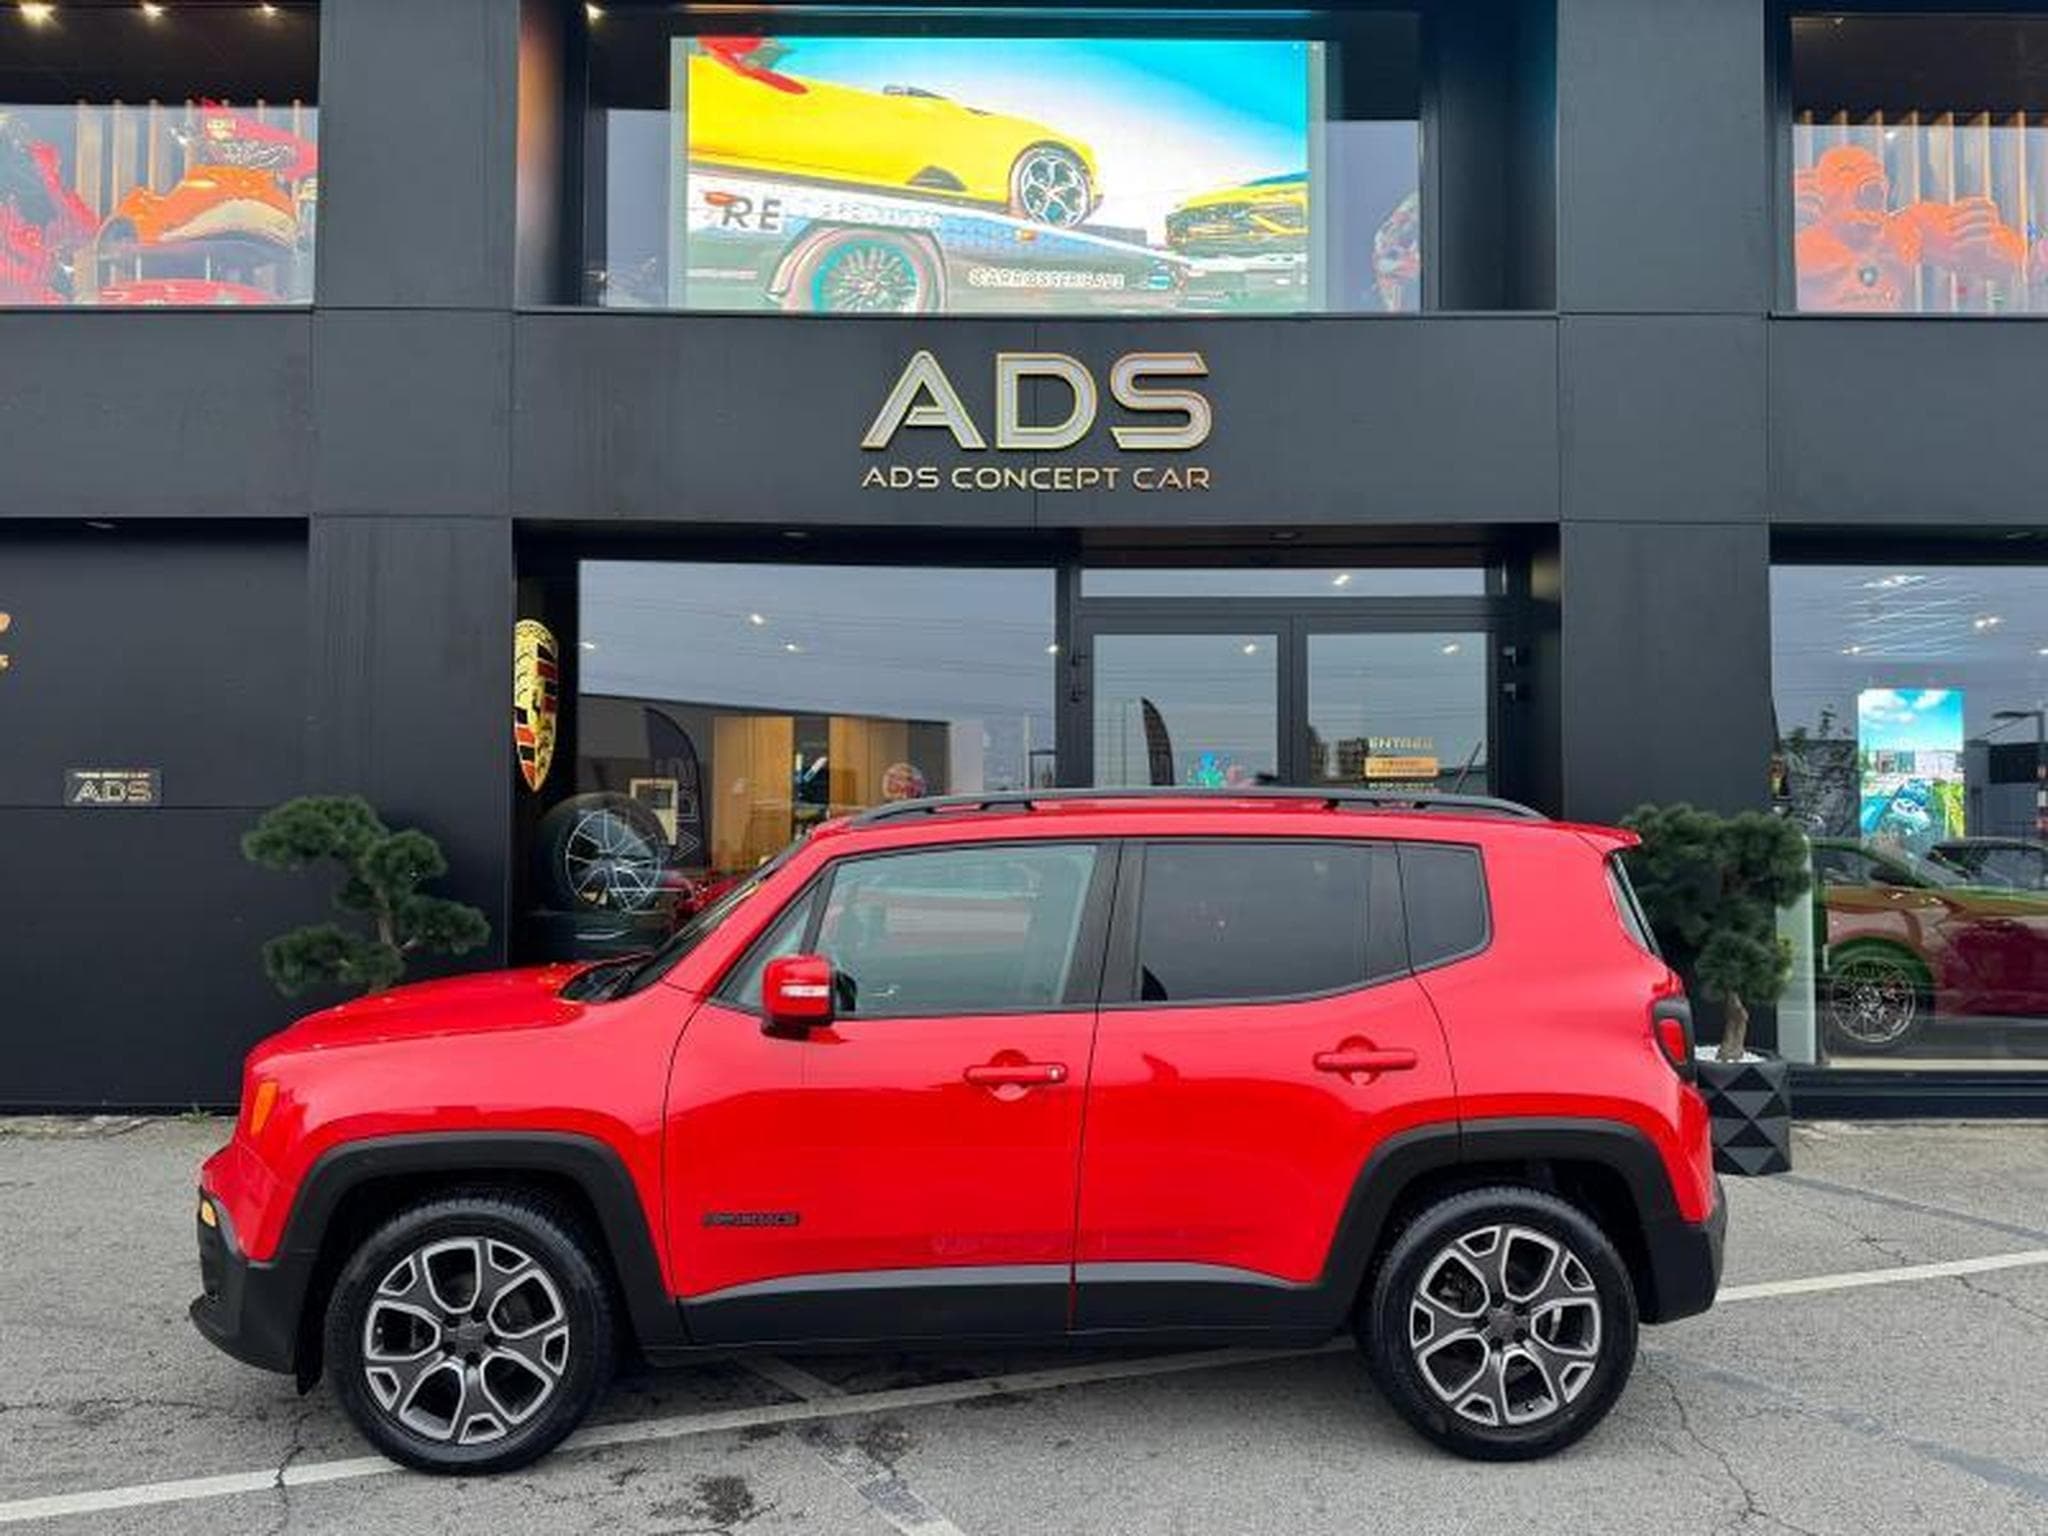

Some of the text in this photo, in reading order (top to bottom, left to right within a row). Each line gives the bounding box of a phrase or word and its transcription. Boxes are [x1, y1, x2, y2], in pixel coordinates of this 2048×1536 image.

[860, 350, 1212, 450] ADS
[861, 467, 1211, 489] ADS CONCEPT CAR
[73, 780, 152, 802] ADS
